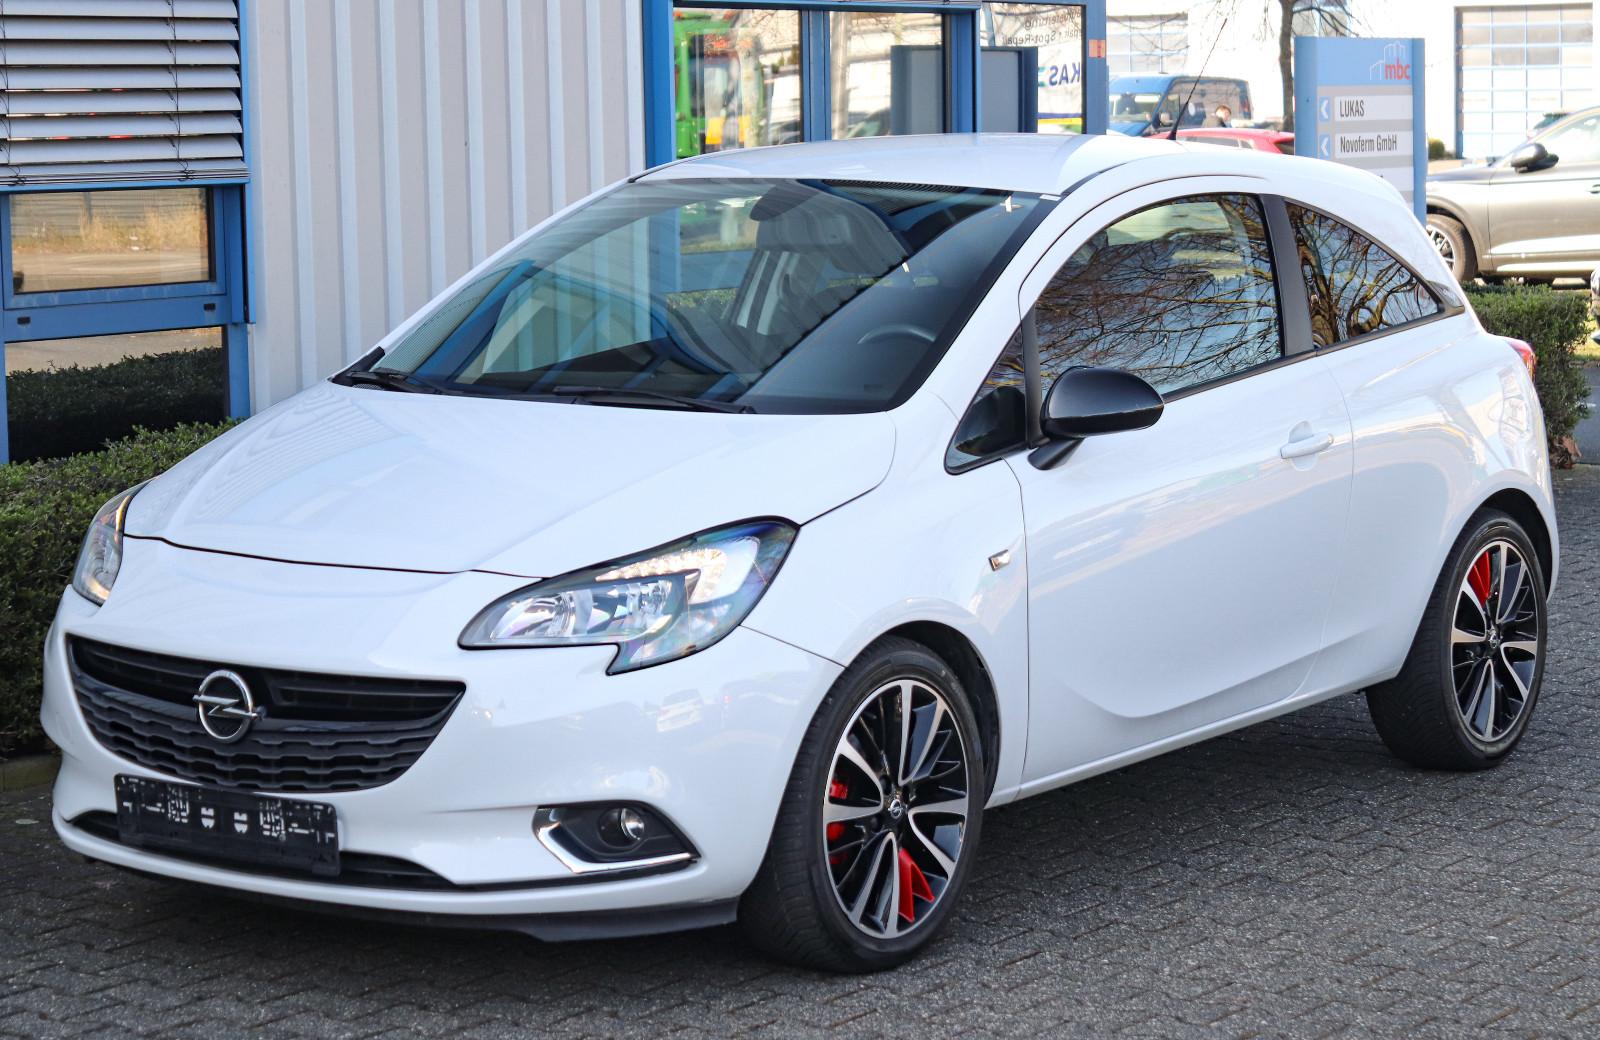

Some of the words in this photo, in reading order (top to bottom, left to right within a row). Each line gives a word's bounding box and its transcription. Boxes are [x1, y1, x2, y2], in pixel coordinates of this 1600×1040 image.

[1384, 58, 1411, 80] mbc
[1340, 100, 1365, 118] LUKAS
[1340, 136, 1375, 153] Novoferm
[1376, 134, 1398, 152] GmbH
